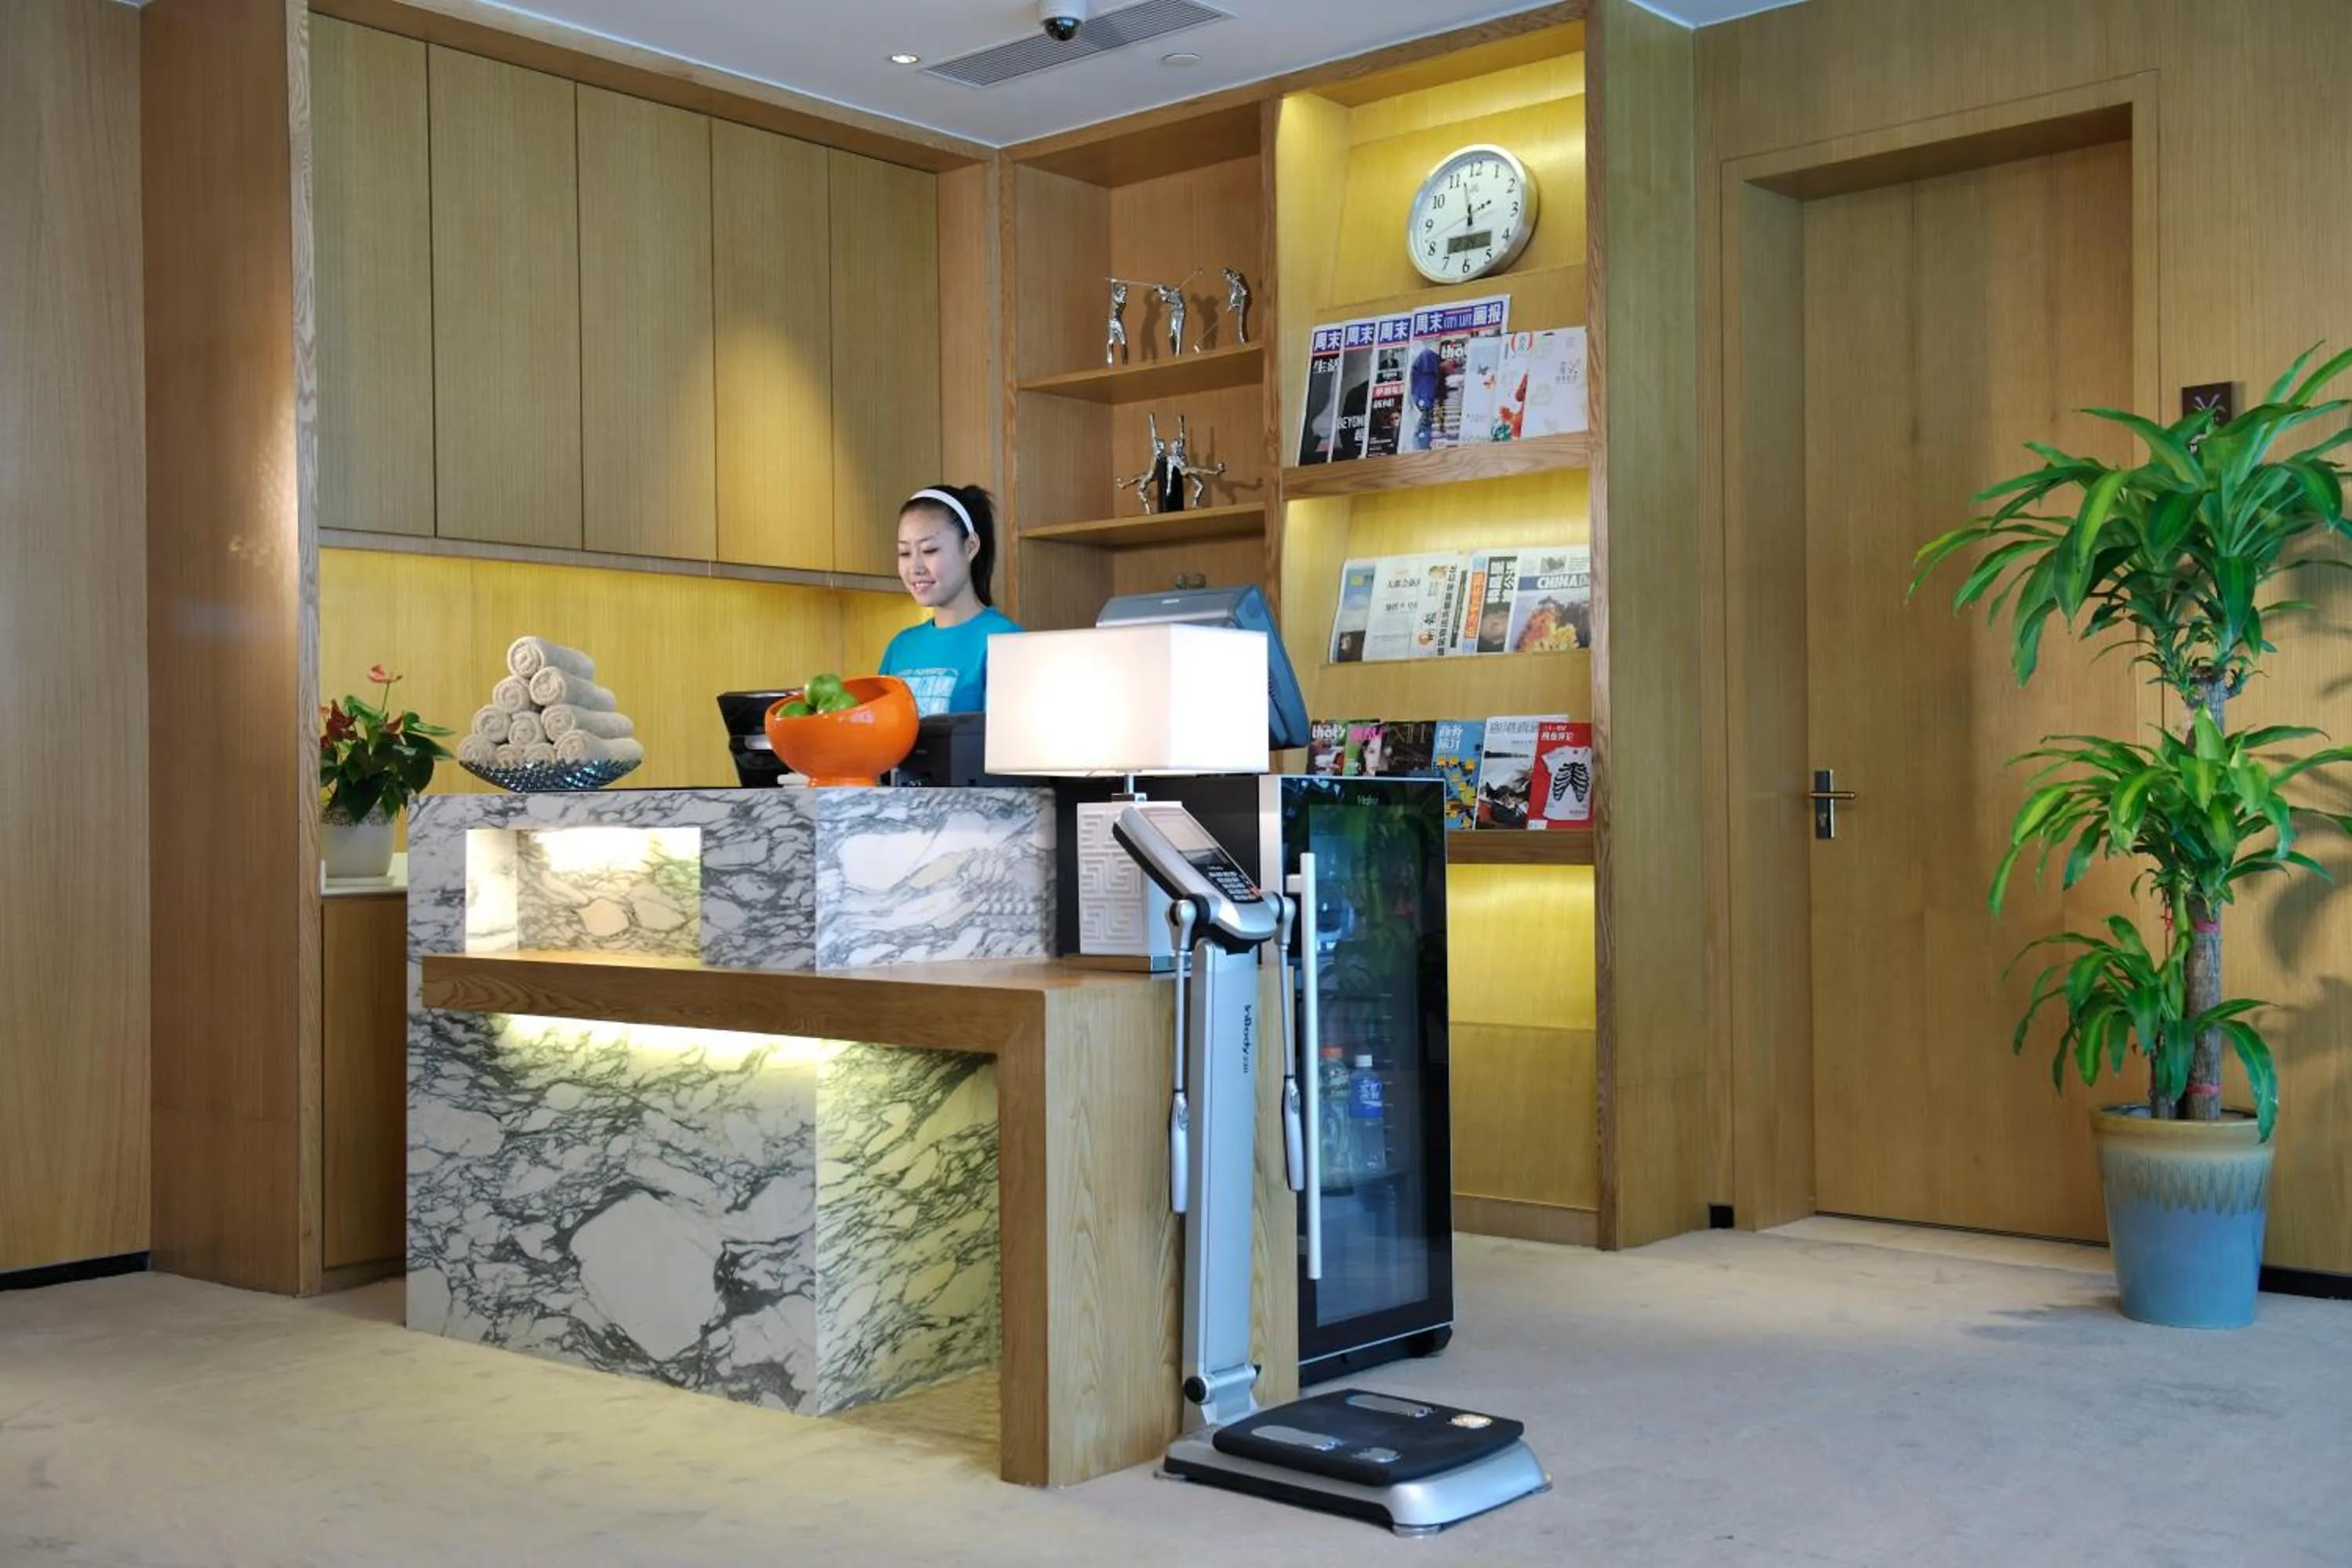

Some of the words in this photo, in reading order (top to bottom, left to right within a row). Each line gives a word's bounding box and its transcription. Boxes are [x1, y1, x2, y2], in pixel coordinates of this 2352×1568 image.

[1469, 162, 1483, 177] 12
[1494, 164, 1500, 178] 1
[1449, 174, 1461, 189] 11
[1506, 178, 1516, 194] 2
[1432, 194, 1446, 209] 10
[1510, 201, 1519, 217] 3
[1425, 219, 1433, 232] 9
[1502, 227, 1509, 240] 4
[1427, 241, 1436, 256] 8
[1484, 248, 1493, 264] 5
[1442, 256, 1450, 270] 7
[1462, 258, 1471, 274] 6
[1415, 312, 1443, 334] 周末
[1473, 303, 1501, 326] 画报
[1345, 325, 1374, 346] 周末
[1378, 321, 1409, 342] 周末
[1313, 330, 1340, 351] 周末
